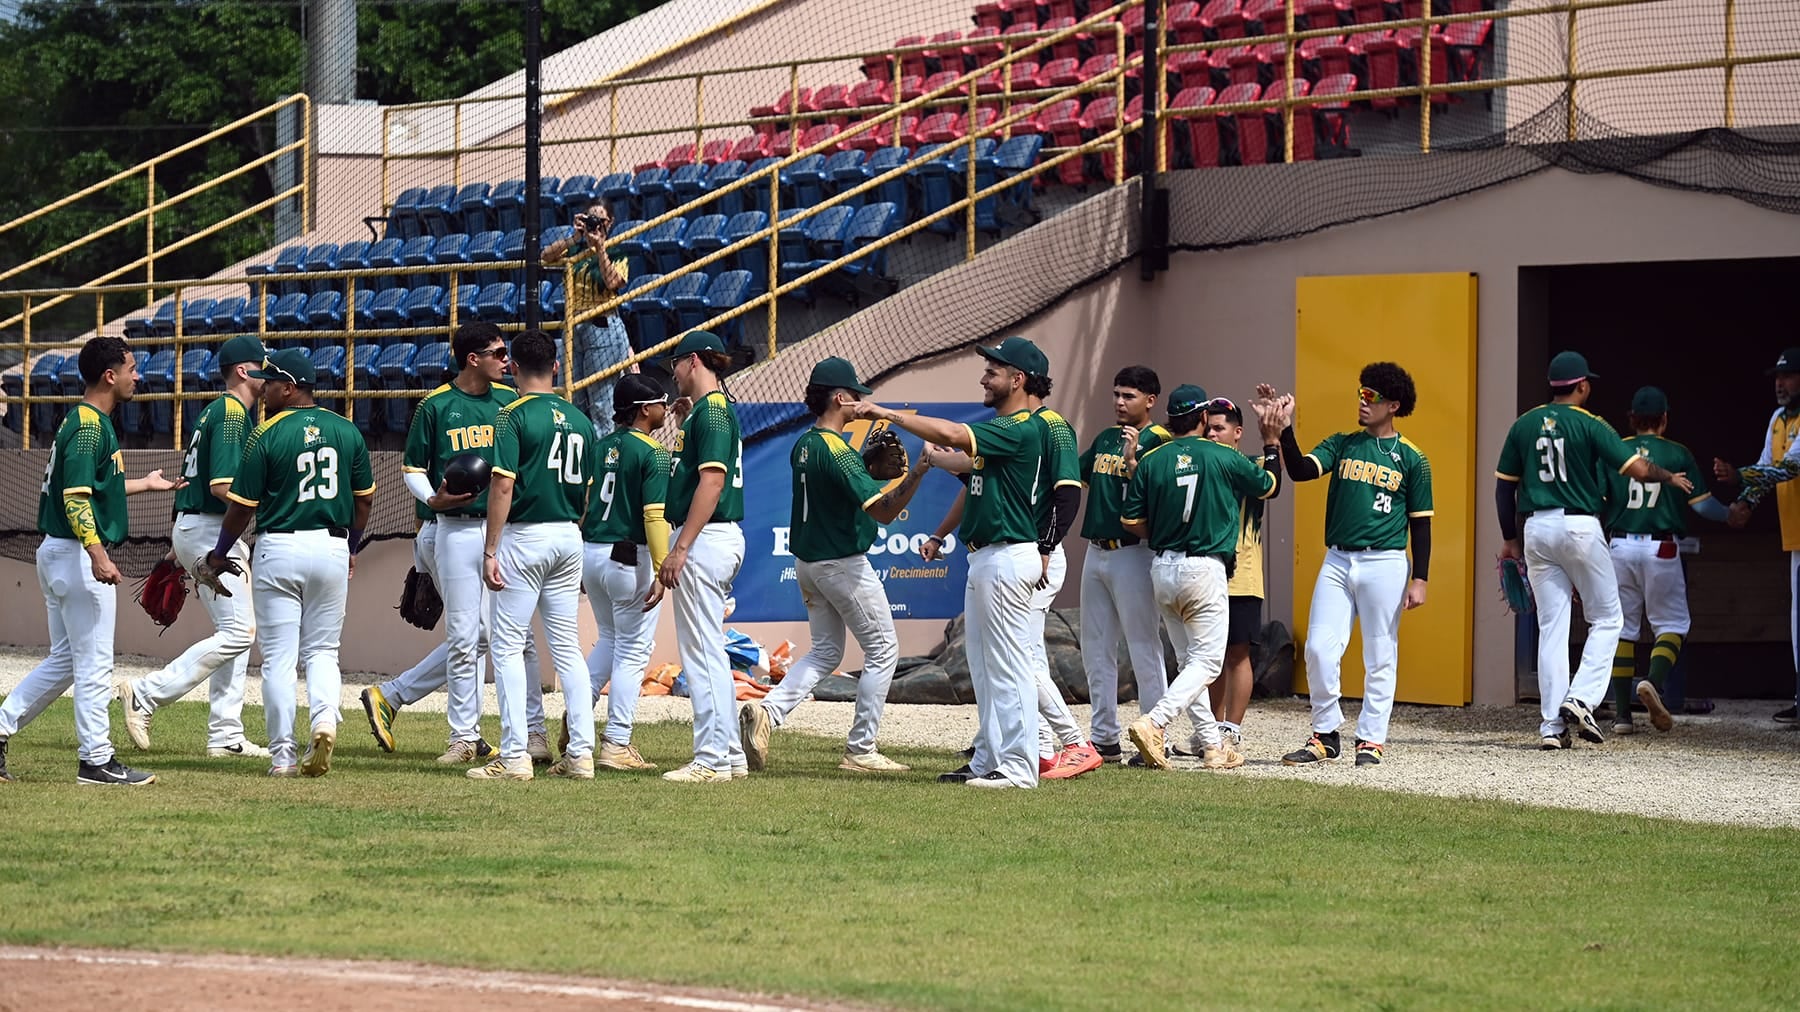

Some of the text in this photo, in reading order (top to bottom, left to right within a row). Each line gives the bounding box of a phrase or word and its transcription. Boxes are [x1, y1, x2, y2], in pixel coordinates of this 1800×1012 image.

[446, 424, 494, 452] TIGR
[547, 431, 584, 485] 40
[297, 446, 338, 503] 23
[1092, 453, 1130, 477] IGRE
[1338, 458, 1403, 492] TIGRES
[1535, 436, 1568, 483] 31
[600, 471, 616, 522] 9
[1176, 473, 1199, 524] 7
[1372, 492, 1393, 514] 28
[889, 565, 949, 579] Crecimiento!
